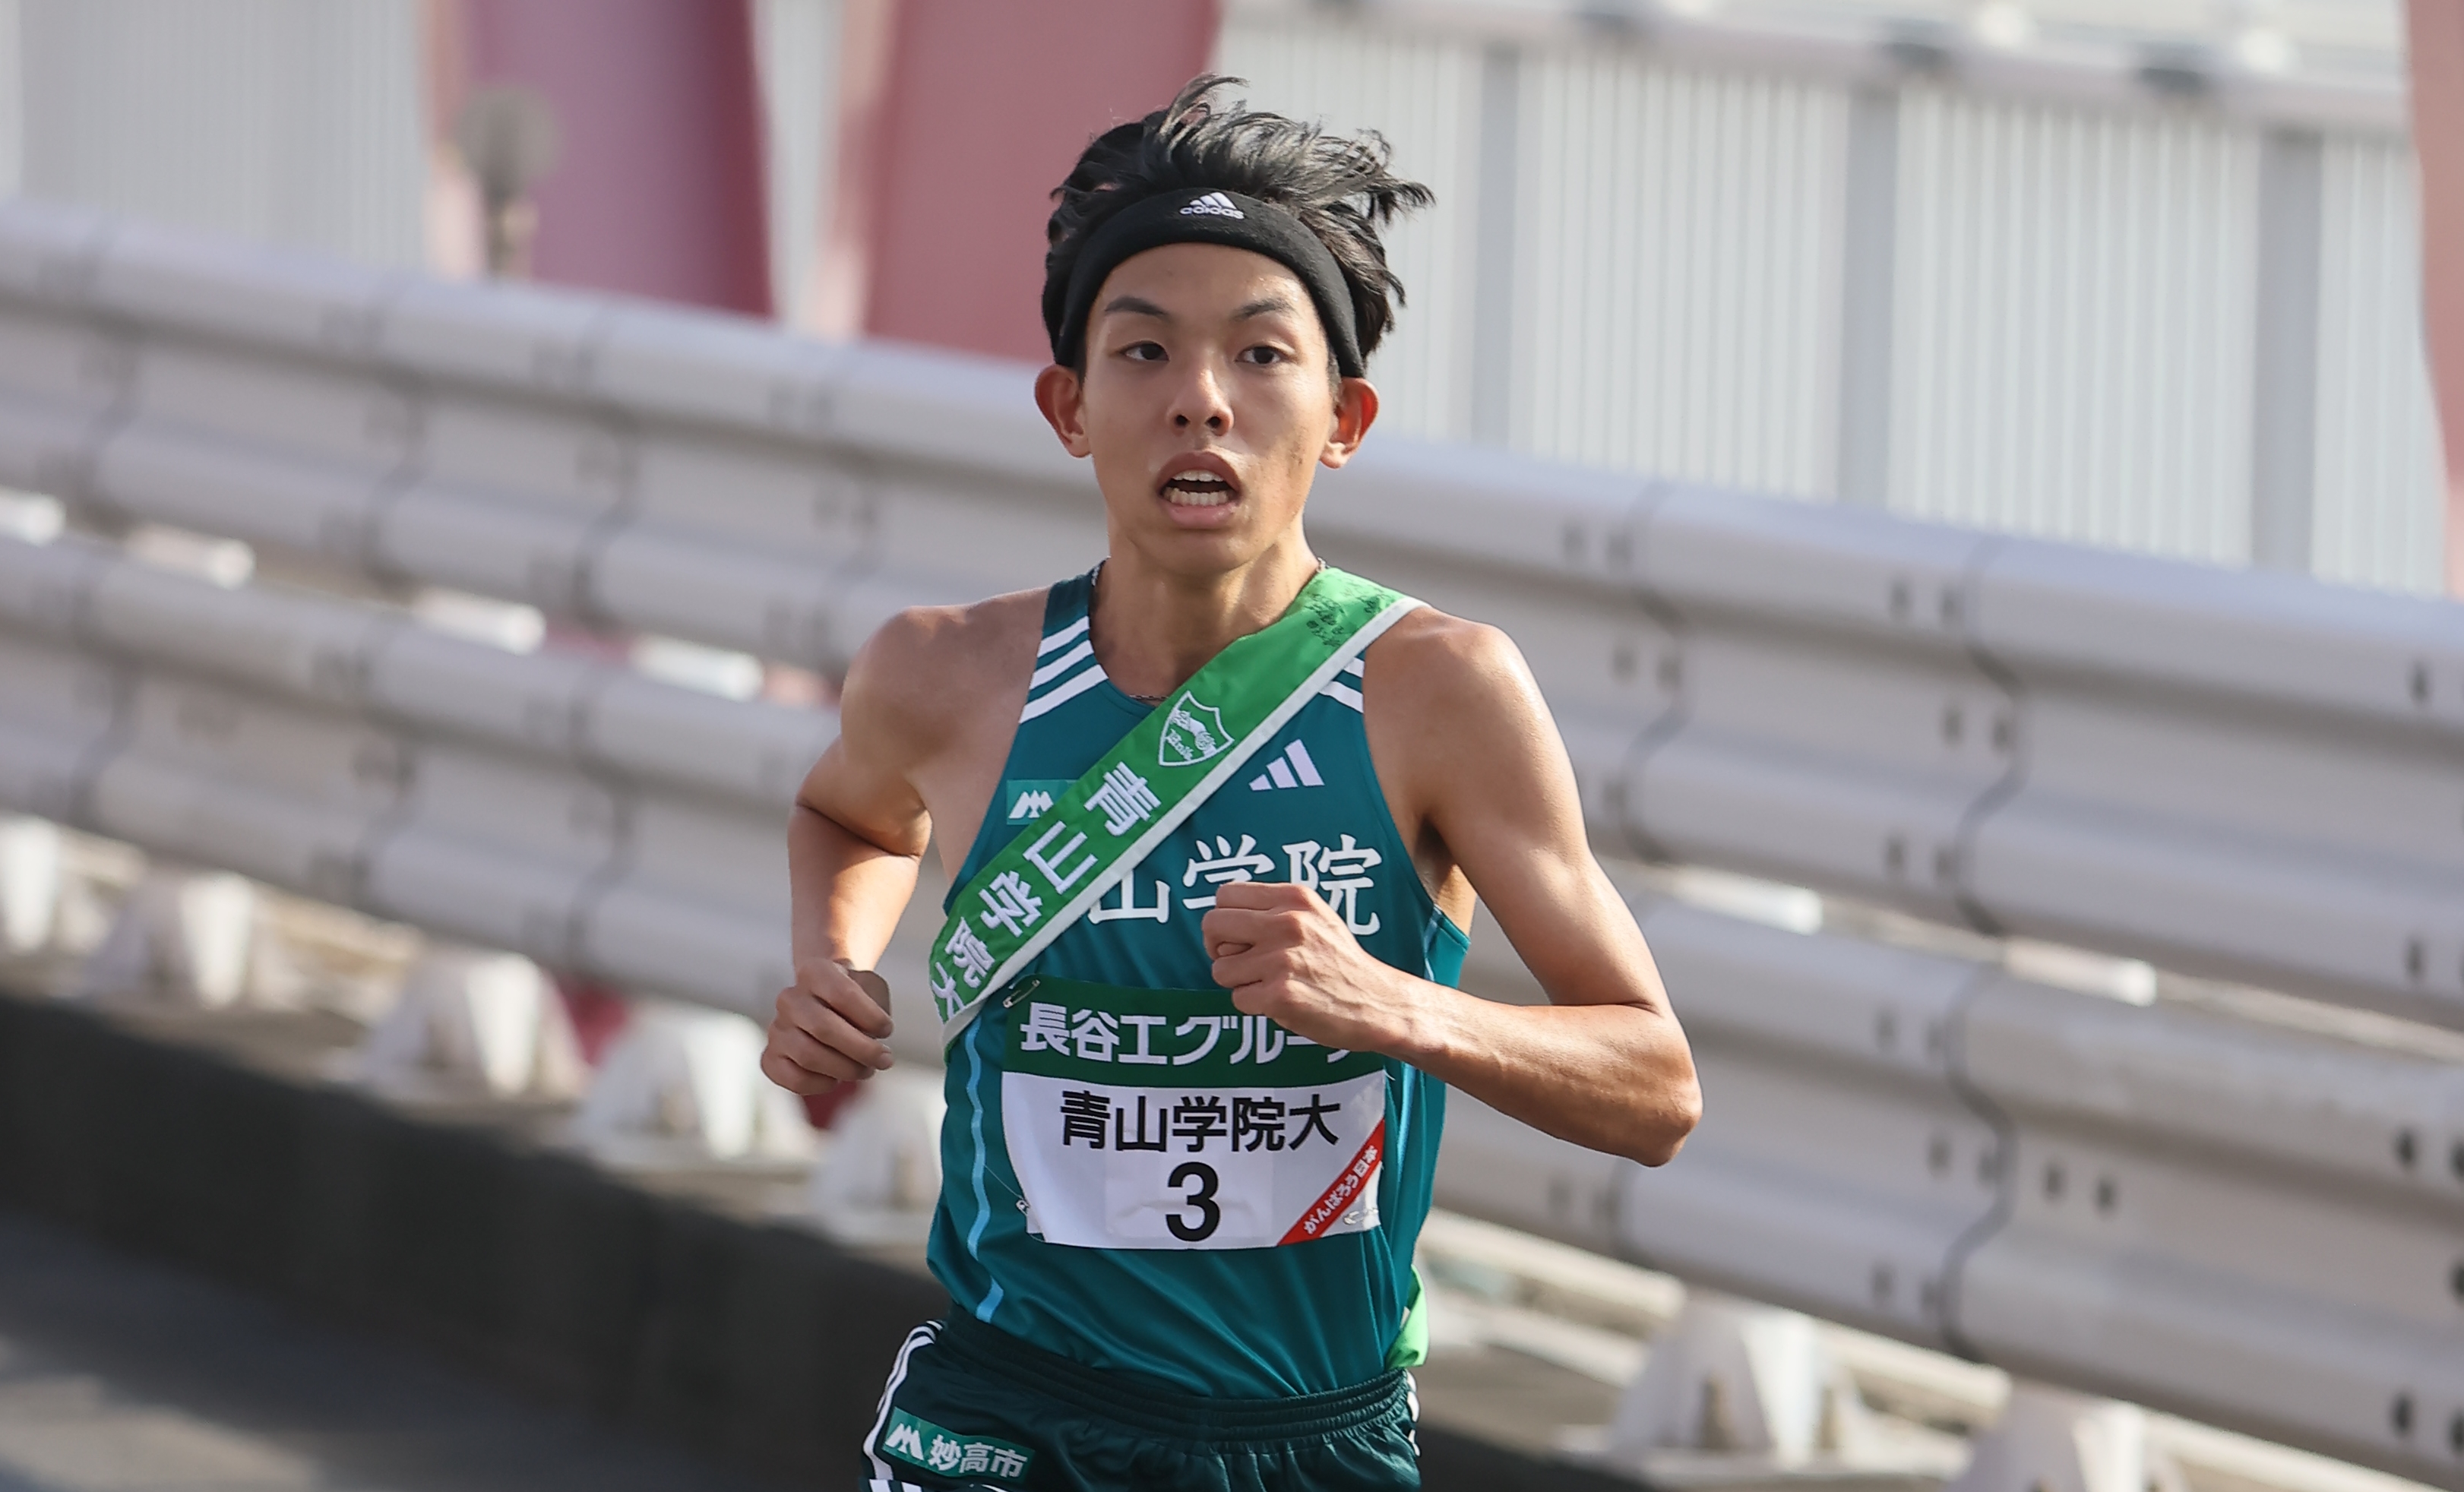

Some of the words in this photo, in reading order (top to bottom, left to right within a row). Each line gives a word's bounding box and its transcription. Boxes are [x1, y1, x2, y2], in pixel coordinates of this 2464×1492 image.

[1179, 205, 1245, 220] adidas
[1020, 1001, 1350, 1065] 長谷工グルー
[1060, 1090, 1341, 1152] 青山学院大
[1165, 1162, 1221, 1242] 3
[1303, 1145, 1378, 1234] がんばろう日本
[928, 1434, 1028, 1478] 妙高市
